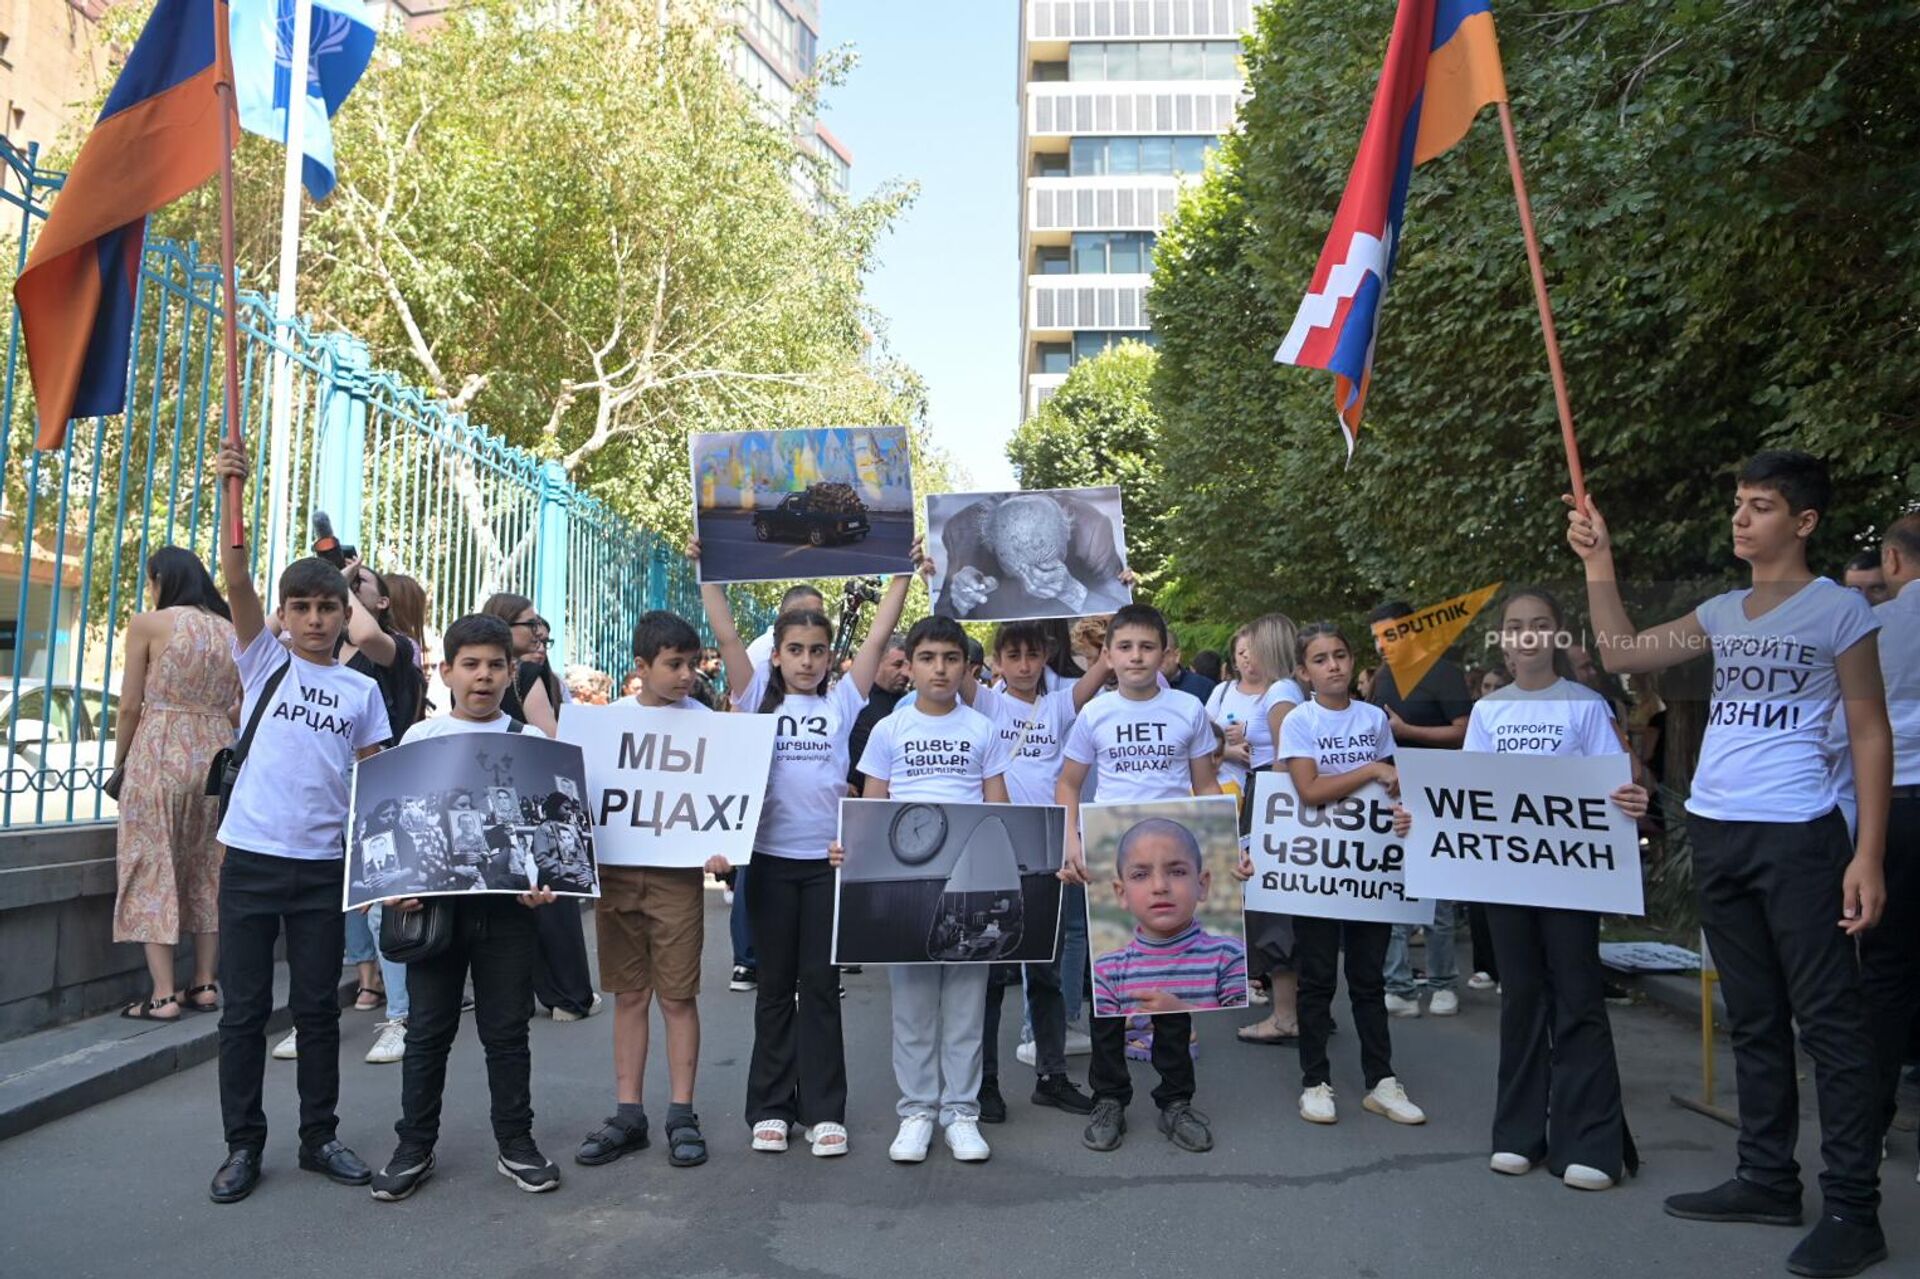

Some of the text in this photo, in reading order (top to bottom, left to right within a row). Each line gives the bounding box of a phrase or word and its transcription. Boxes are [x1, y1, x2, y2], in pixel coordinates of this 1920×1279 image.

[1717, 637, 1817, 666] КРОЙТЕ
[1712, 666, 1811, 697] ОРОГУ
[273, 702, 354, 740] АРЦАХ!
[1497, 722, 1564, 736] ОТКРОЙТЕ
[1710, 702, 1800, 730] ИЗНИ!
[1001, 729, 1056, 744] ԱՐԱԽՆ
[1117, 722, 1167, 743] НЕТ
[1318, 734, 1377, 750] WE ARE
[1497, 737, 1562, 752] ДОРОГУ
[618, 732, 707, 774] МЫ
[905, 754, 970, 767] ԿՅԱՆՔԻ
[1109, 745, 1176, 759] БЛОКАДЕ
[1264, 792, 1398, 834] ԲԱՑԵ
[1424, 786, 1610, 831] WE ARE
[1263, 834, 1405, 873] ԿՅԱՆՔ
[1430, 831, 1615, 870] ARTSAKH
[1262, 871, 1419, 902] ՃԱՆԱՊԱՐՀ
